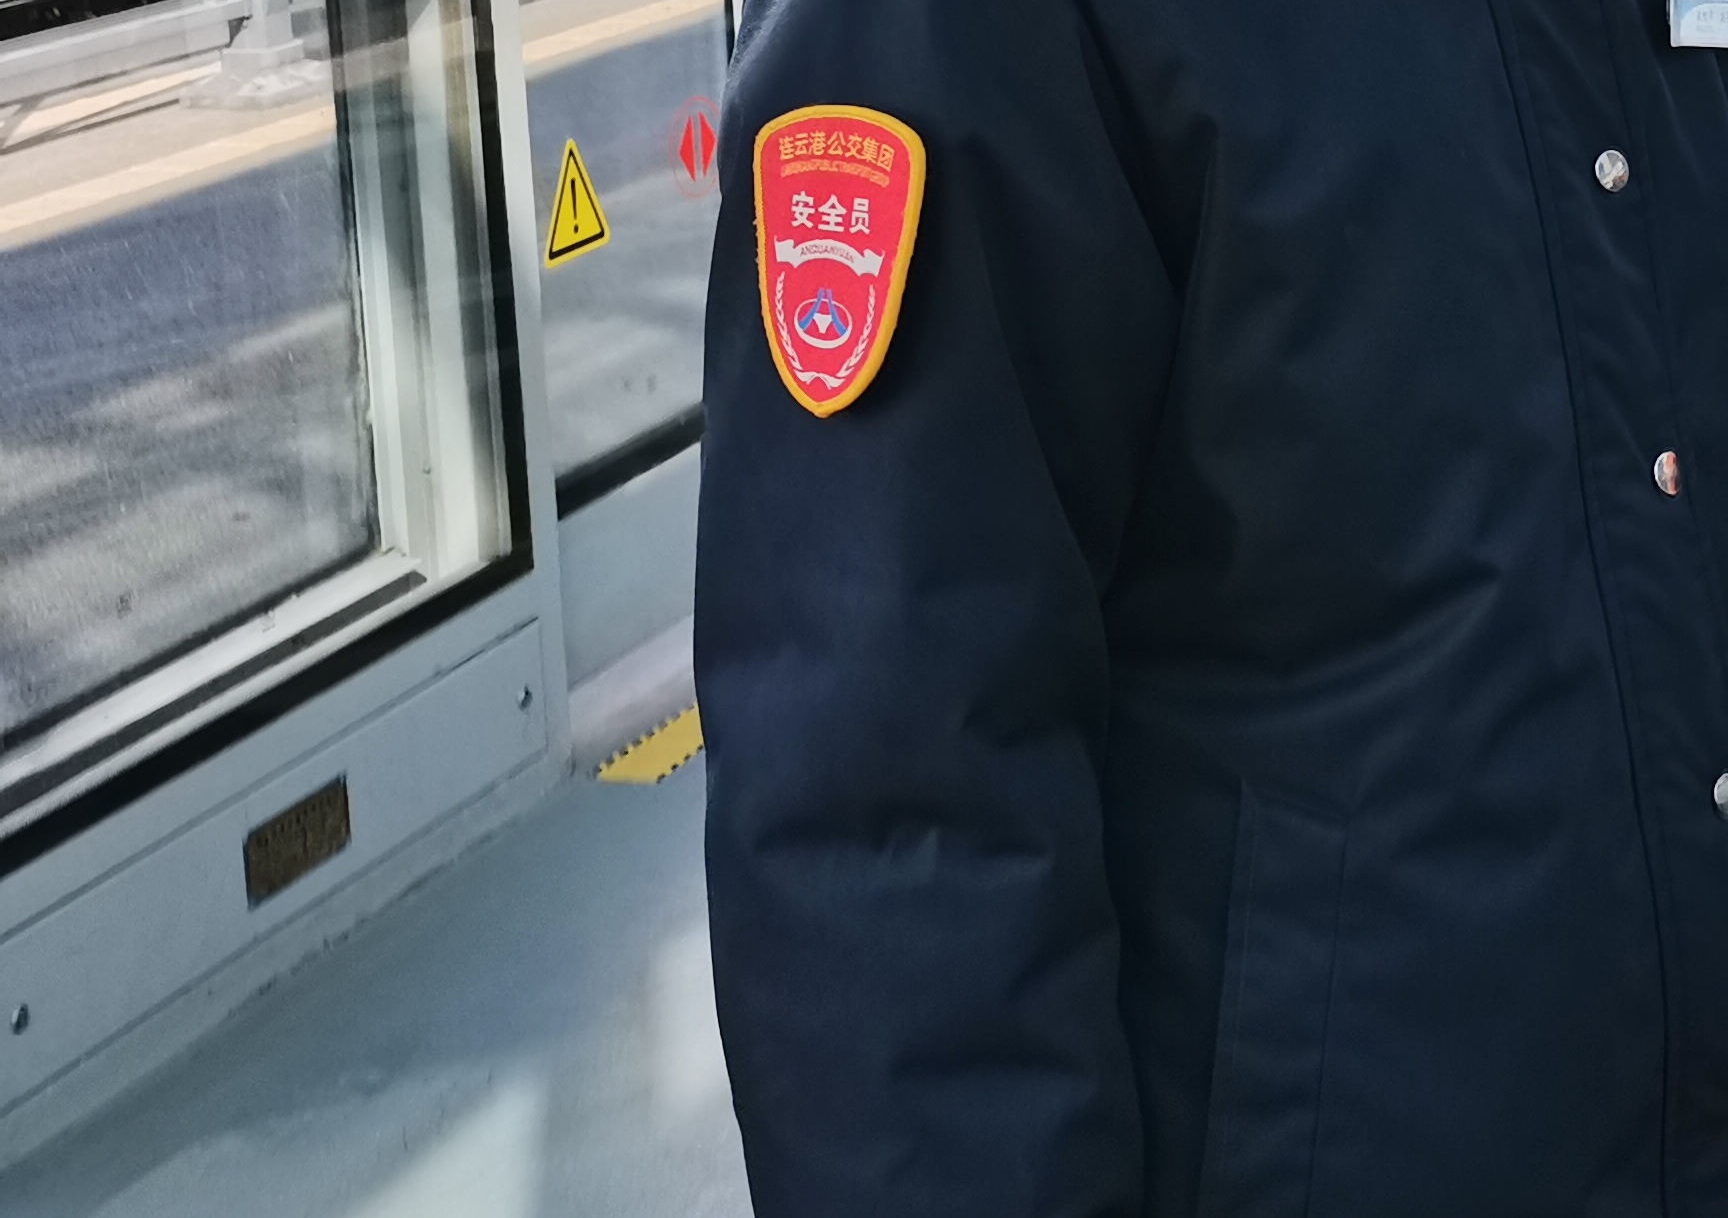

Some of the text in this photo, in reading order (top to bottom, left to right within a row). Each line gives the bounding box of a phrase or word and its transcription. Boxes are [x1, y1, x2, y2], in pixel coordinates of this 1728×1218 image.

[778, 130, 896, 172] 连云港公交集团
[790, 190, 871, 235] 安全员
